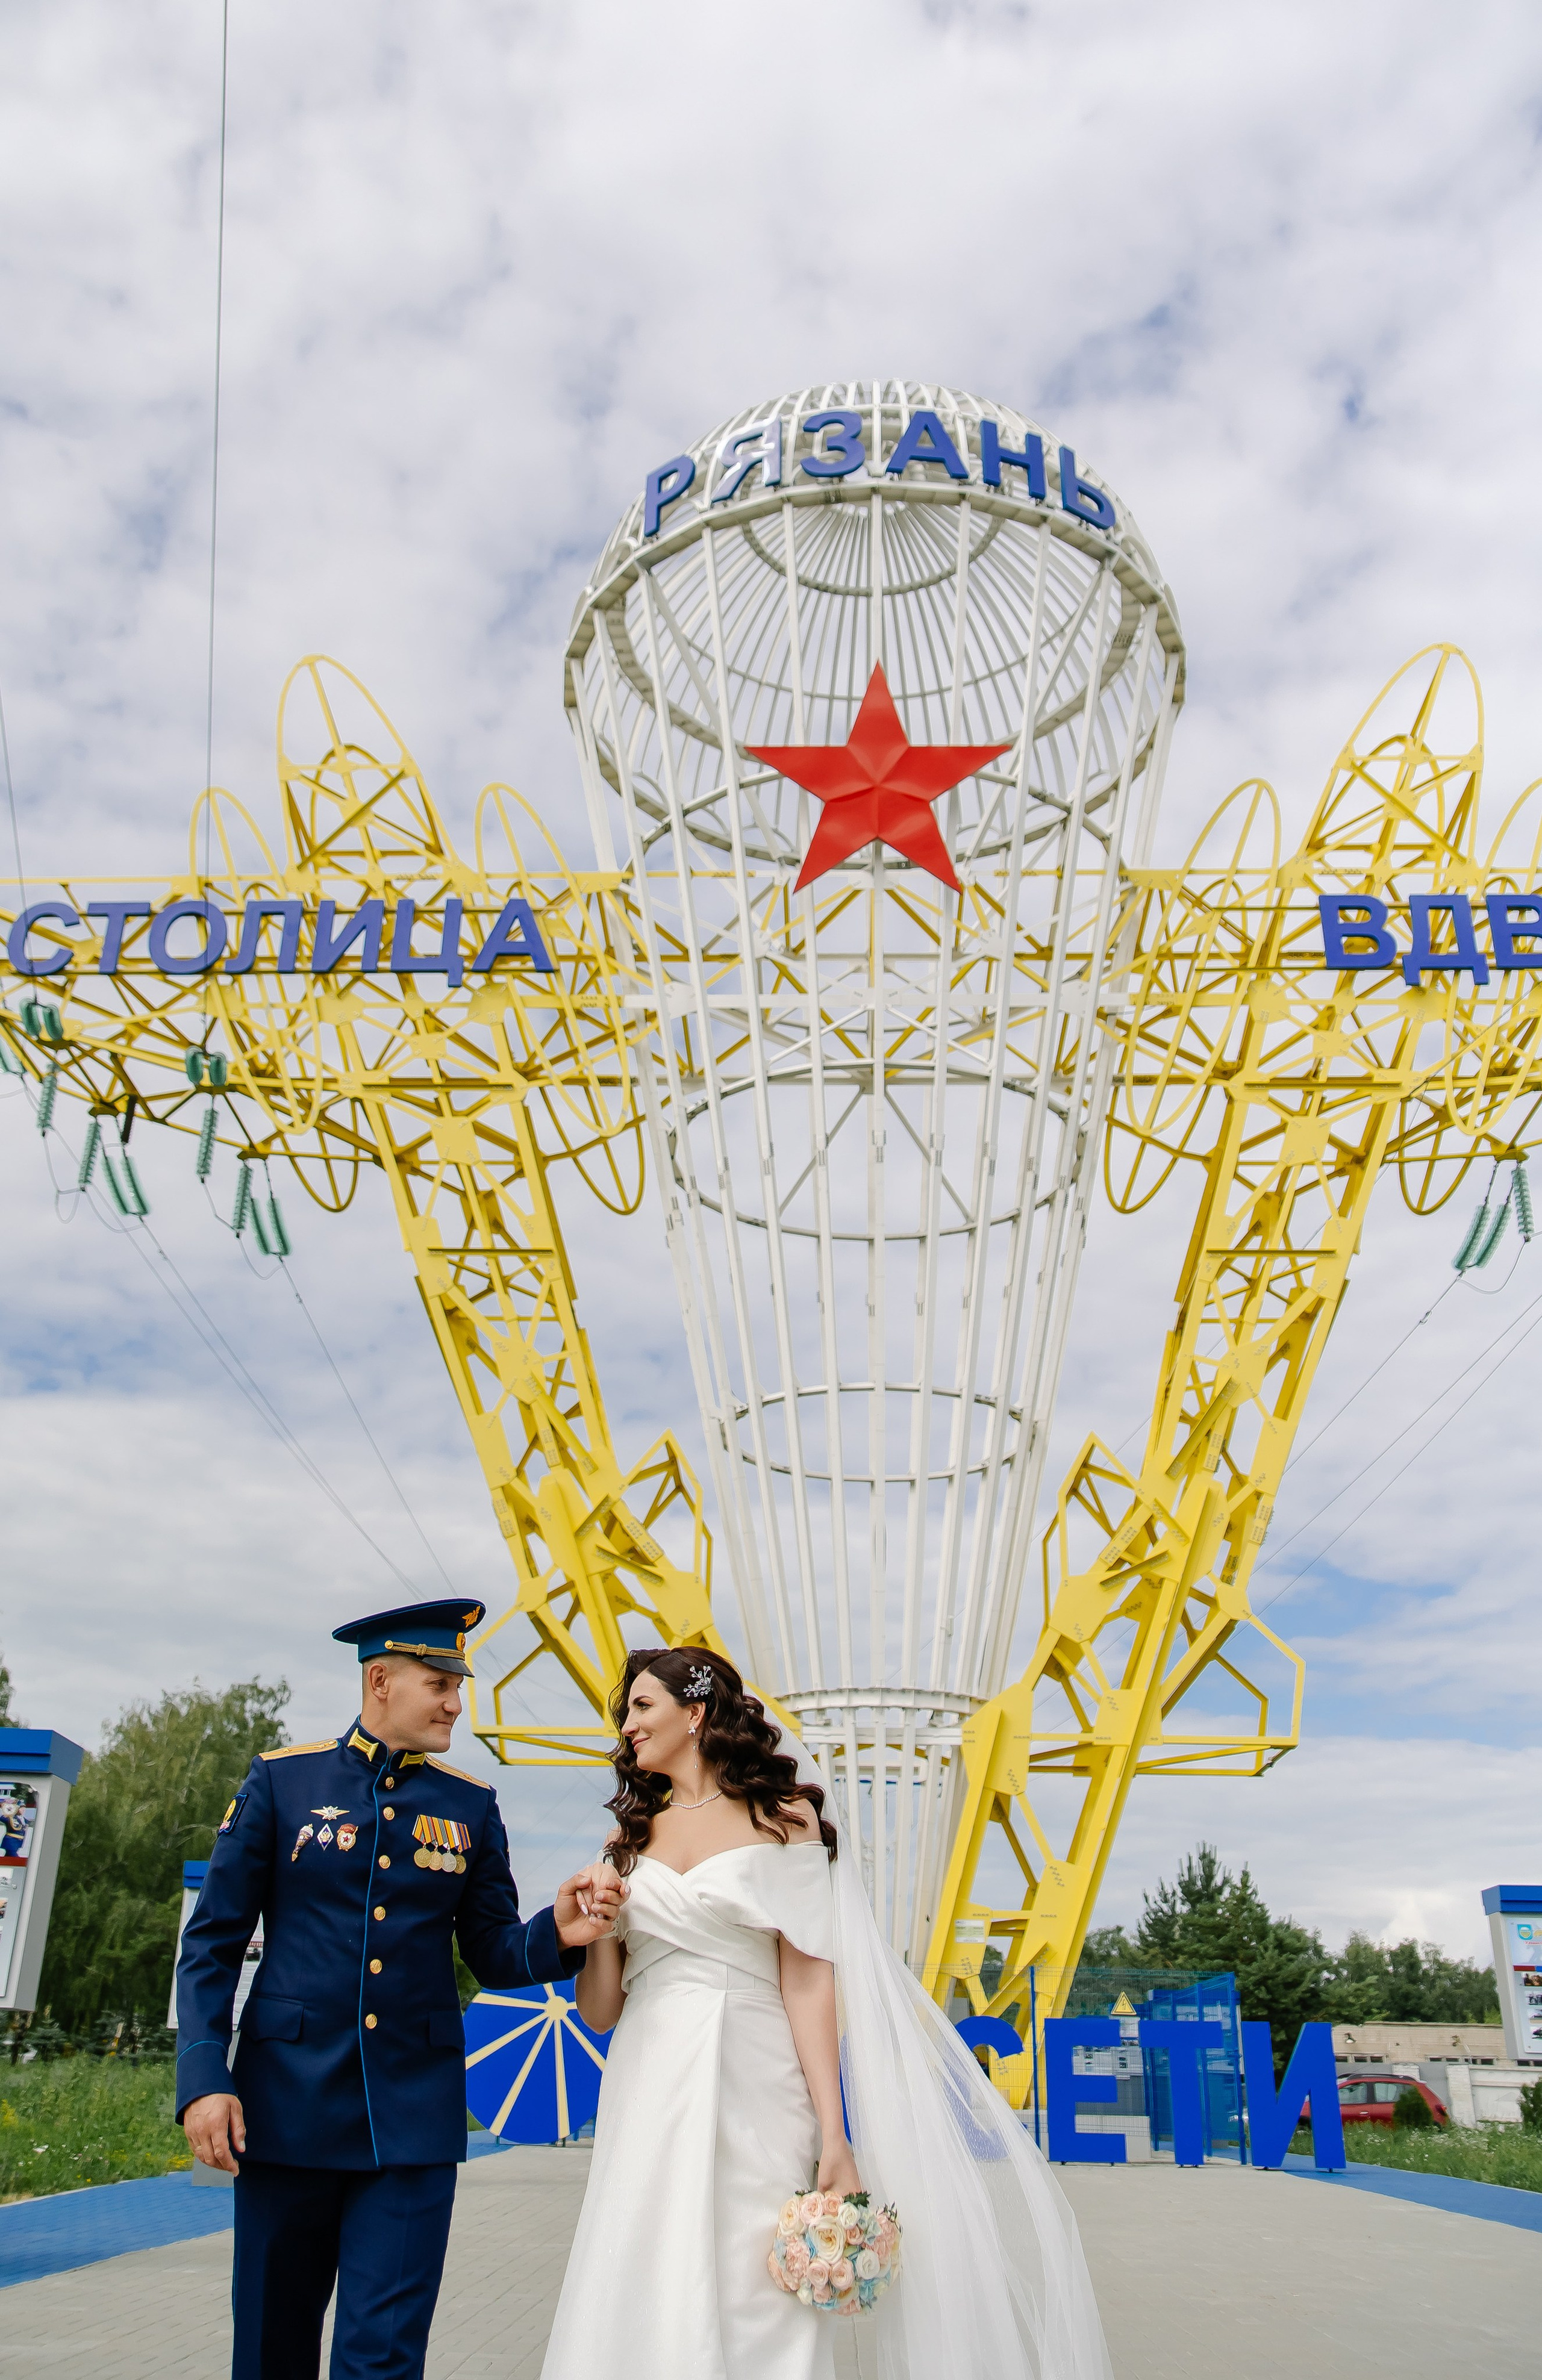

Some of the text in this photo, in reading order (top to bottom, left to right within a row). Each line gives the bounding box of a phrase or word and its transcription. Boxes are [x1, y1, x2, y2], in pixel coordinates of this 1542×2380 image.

[645, 411, 1117, 537] РЯЗАНЬ
[7, 899, 555, 987] СТОЛИЦА
[1319, 894, 1542, 985] ВДВ
